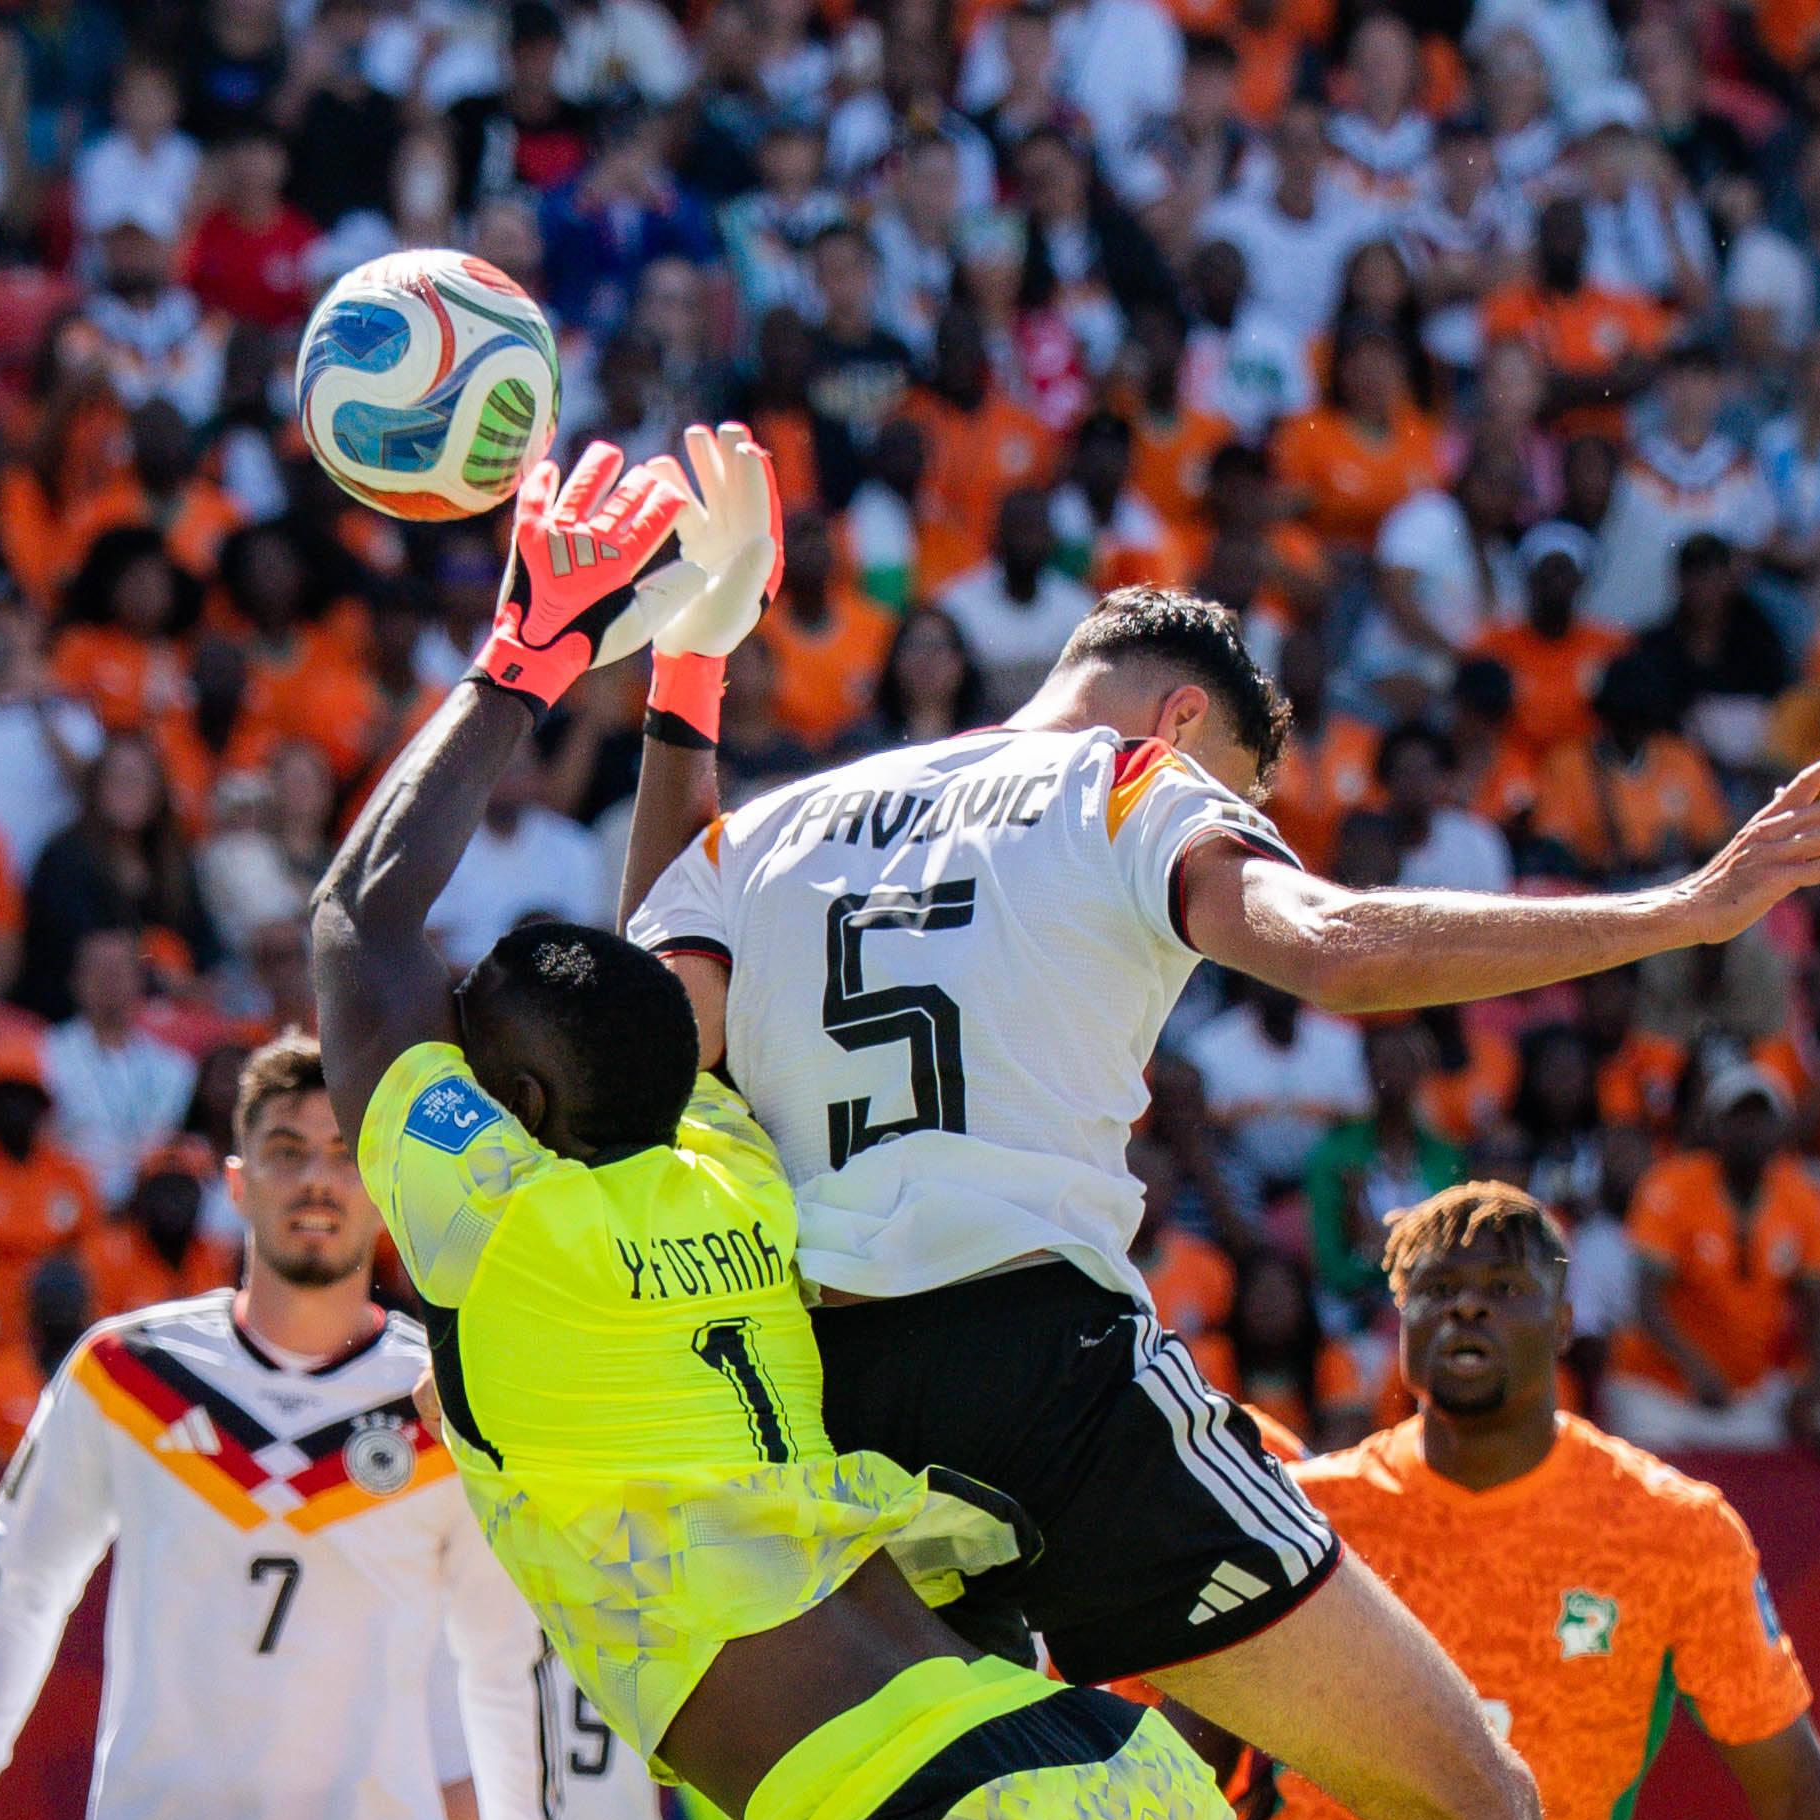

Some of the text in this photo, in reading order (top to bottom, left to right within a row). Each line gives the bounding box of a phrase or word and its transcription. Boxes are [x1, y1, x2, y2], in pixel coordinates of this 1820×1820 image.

[790, 763, 1059, 850] PAVLOVIĆ
[824, 878, 976, 1171] 5
[691, 1316, 798, 1464] 1
[249, 1554, 301, 1654] 7
[570, 1684, 611, 1775] 5
